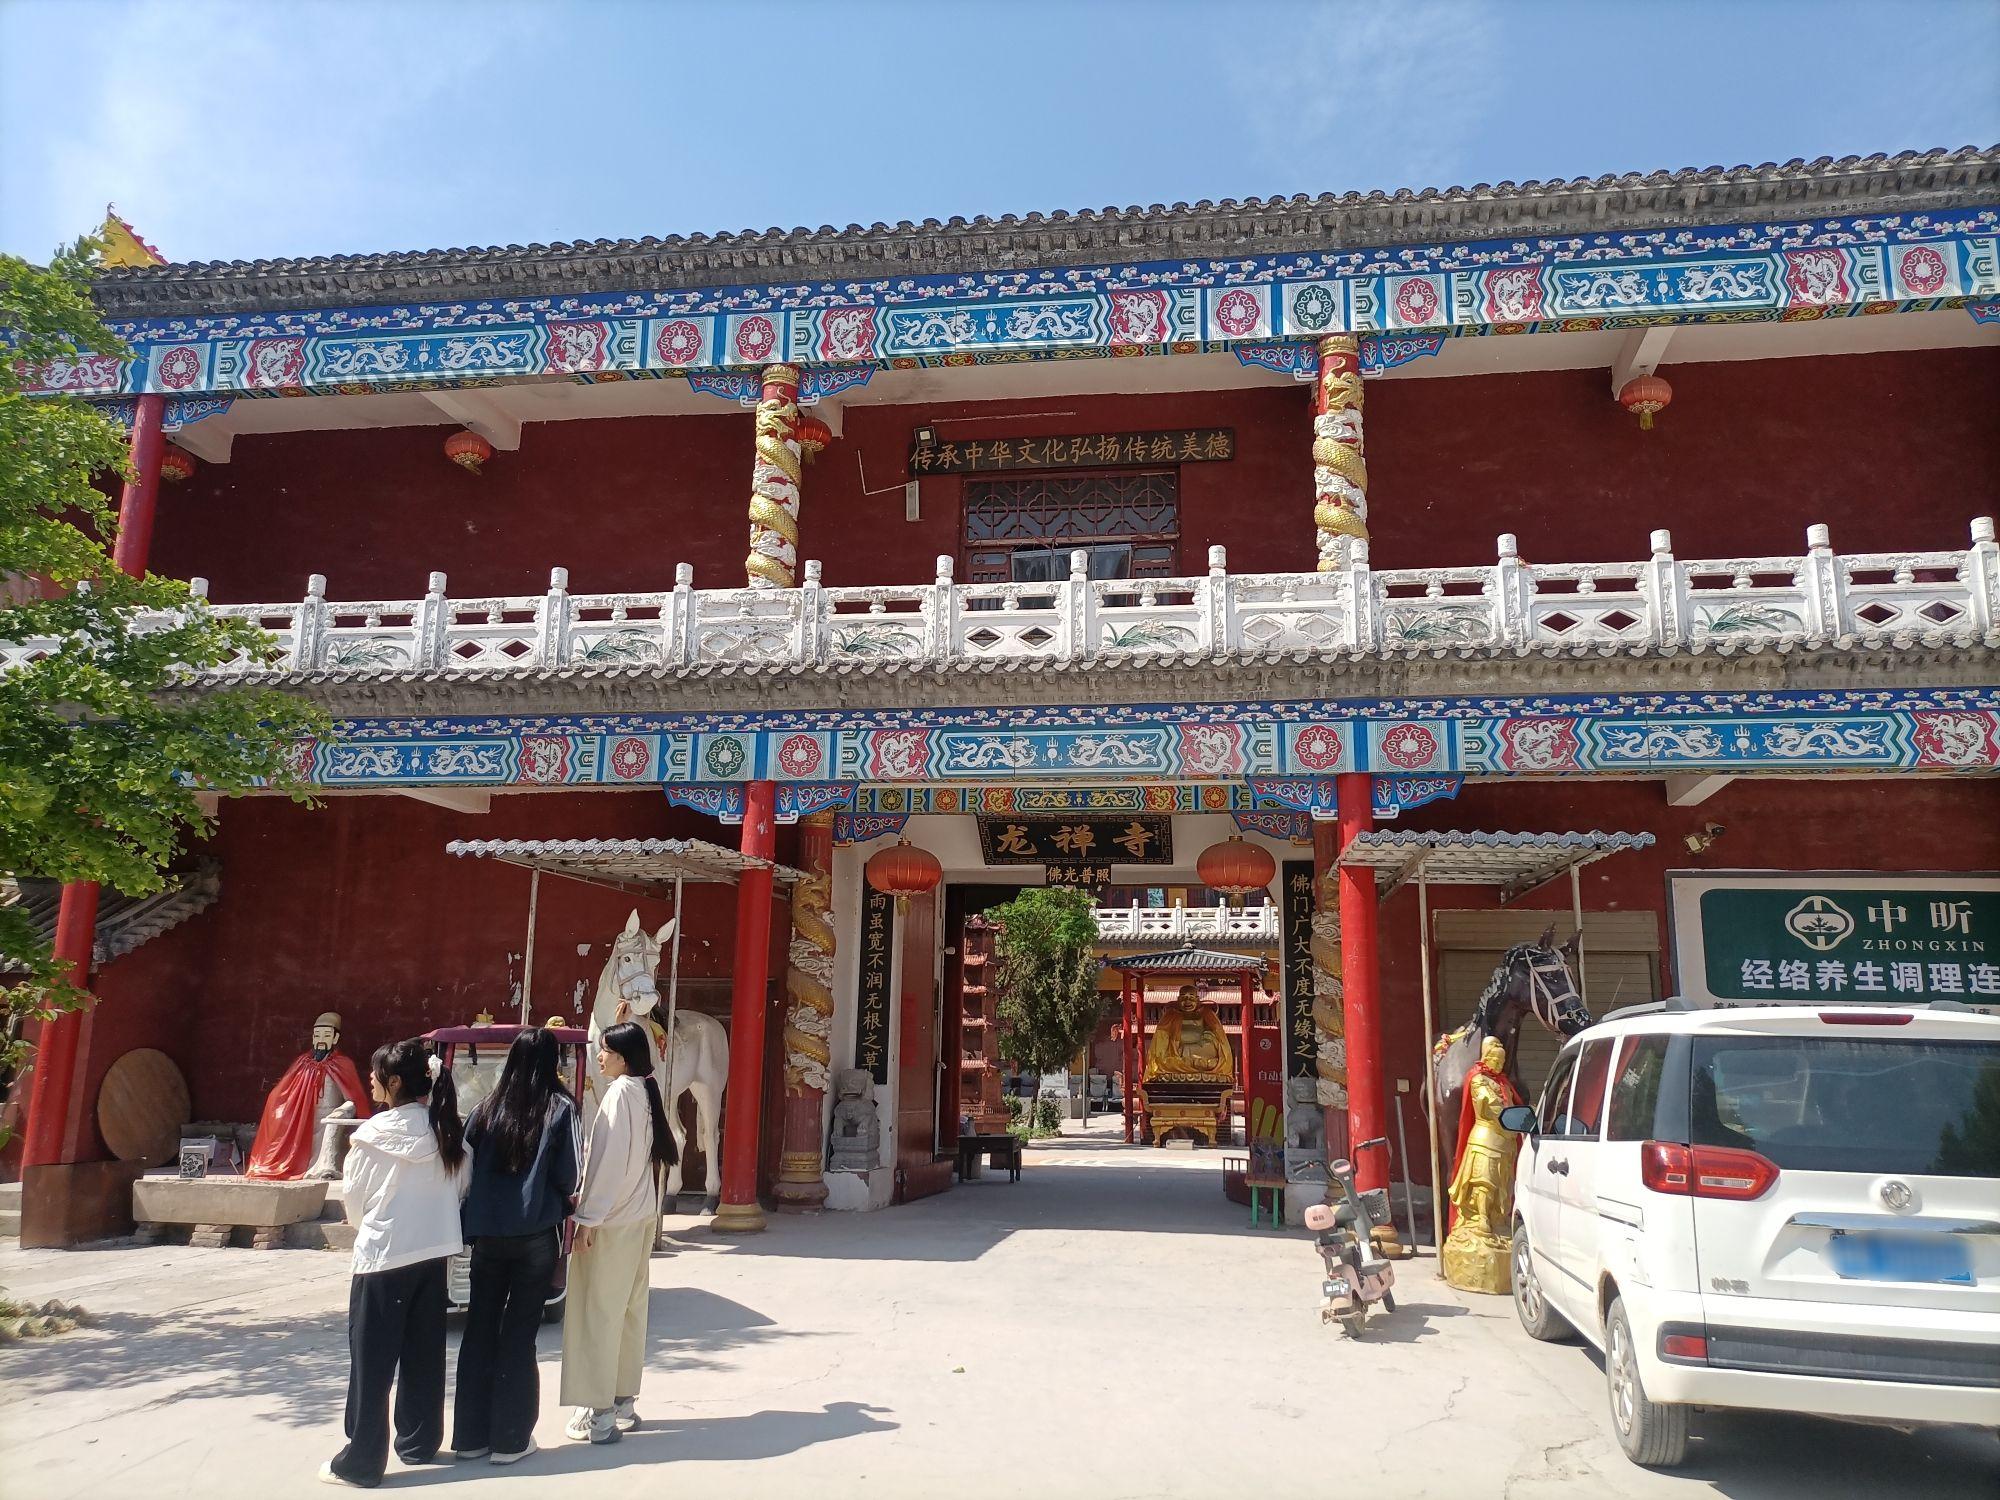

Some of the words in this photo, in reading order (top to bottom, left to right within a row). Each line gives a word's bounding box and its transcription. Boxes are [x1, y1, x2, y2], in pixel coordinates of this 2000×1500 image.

[910, 431, 1231, 472] 传承中华文化弘扬传统美德
[997, 822, 1154, 858] 龙禅寺
[1046, 866, 1111, 884] 佛光普照
[1867, 899, 1974, 935] 中昕
[1862, 938, 1986, 952] ZHONGXIN
[862, 886, 887, 1072] 雨虽宽不润无根之草
[1289, 873, 1317, 1079] 佛门广大不度无缘之人
[1740, 957, 2000, 995] 经络养生调理连
[1258, 1070, 1282, 1081] 自动
